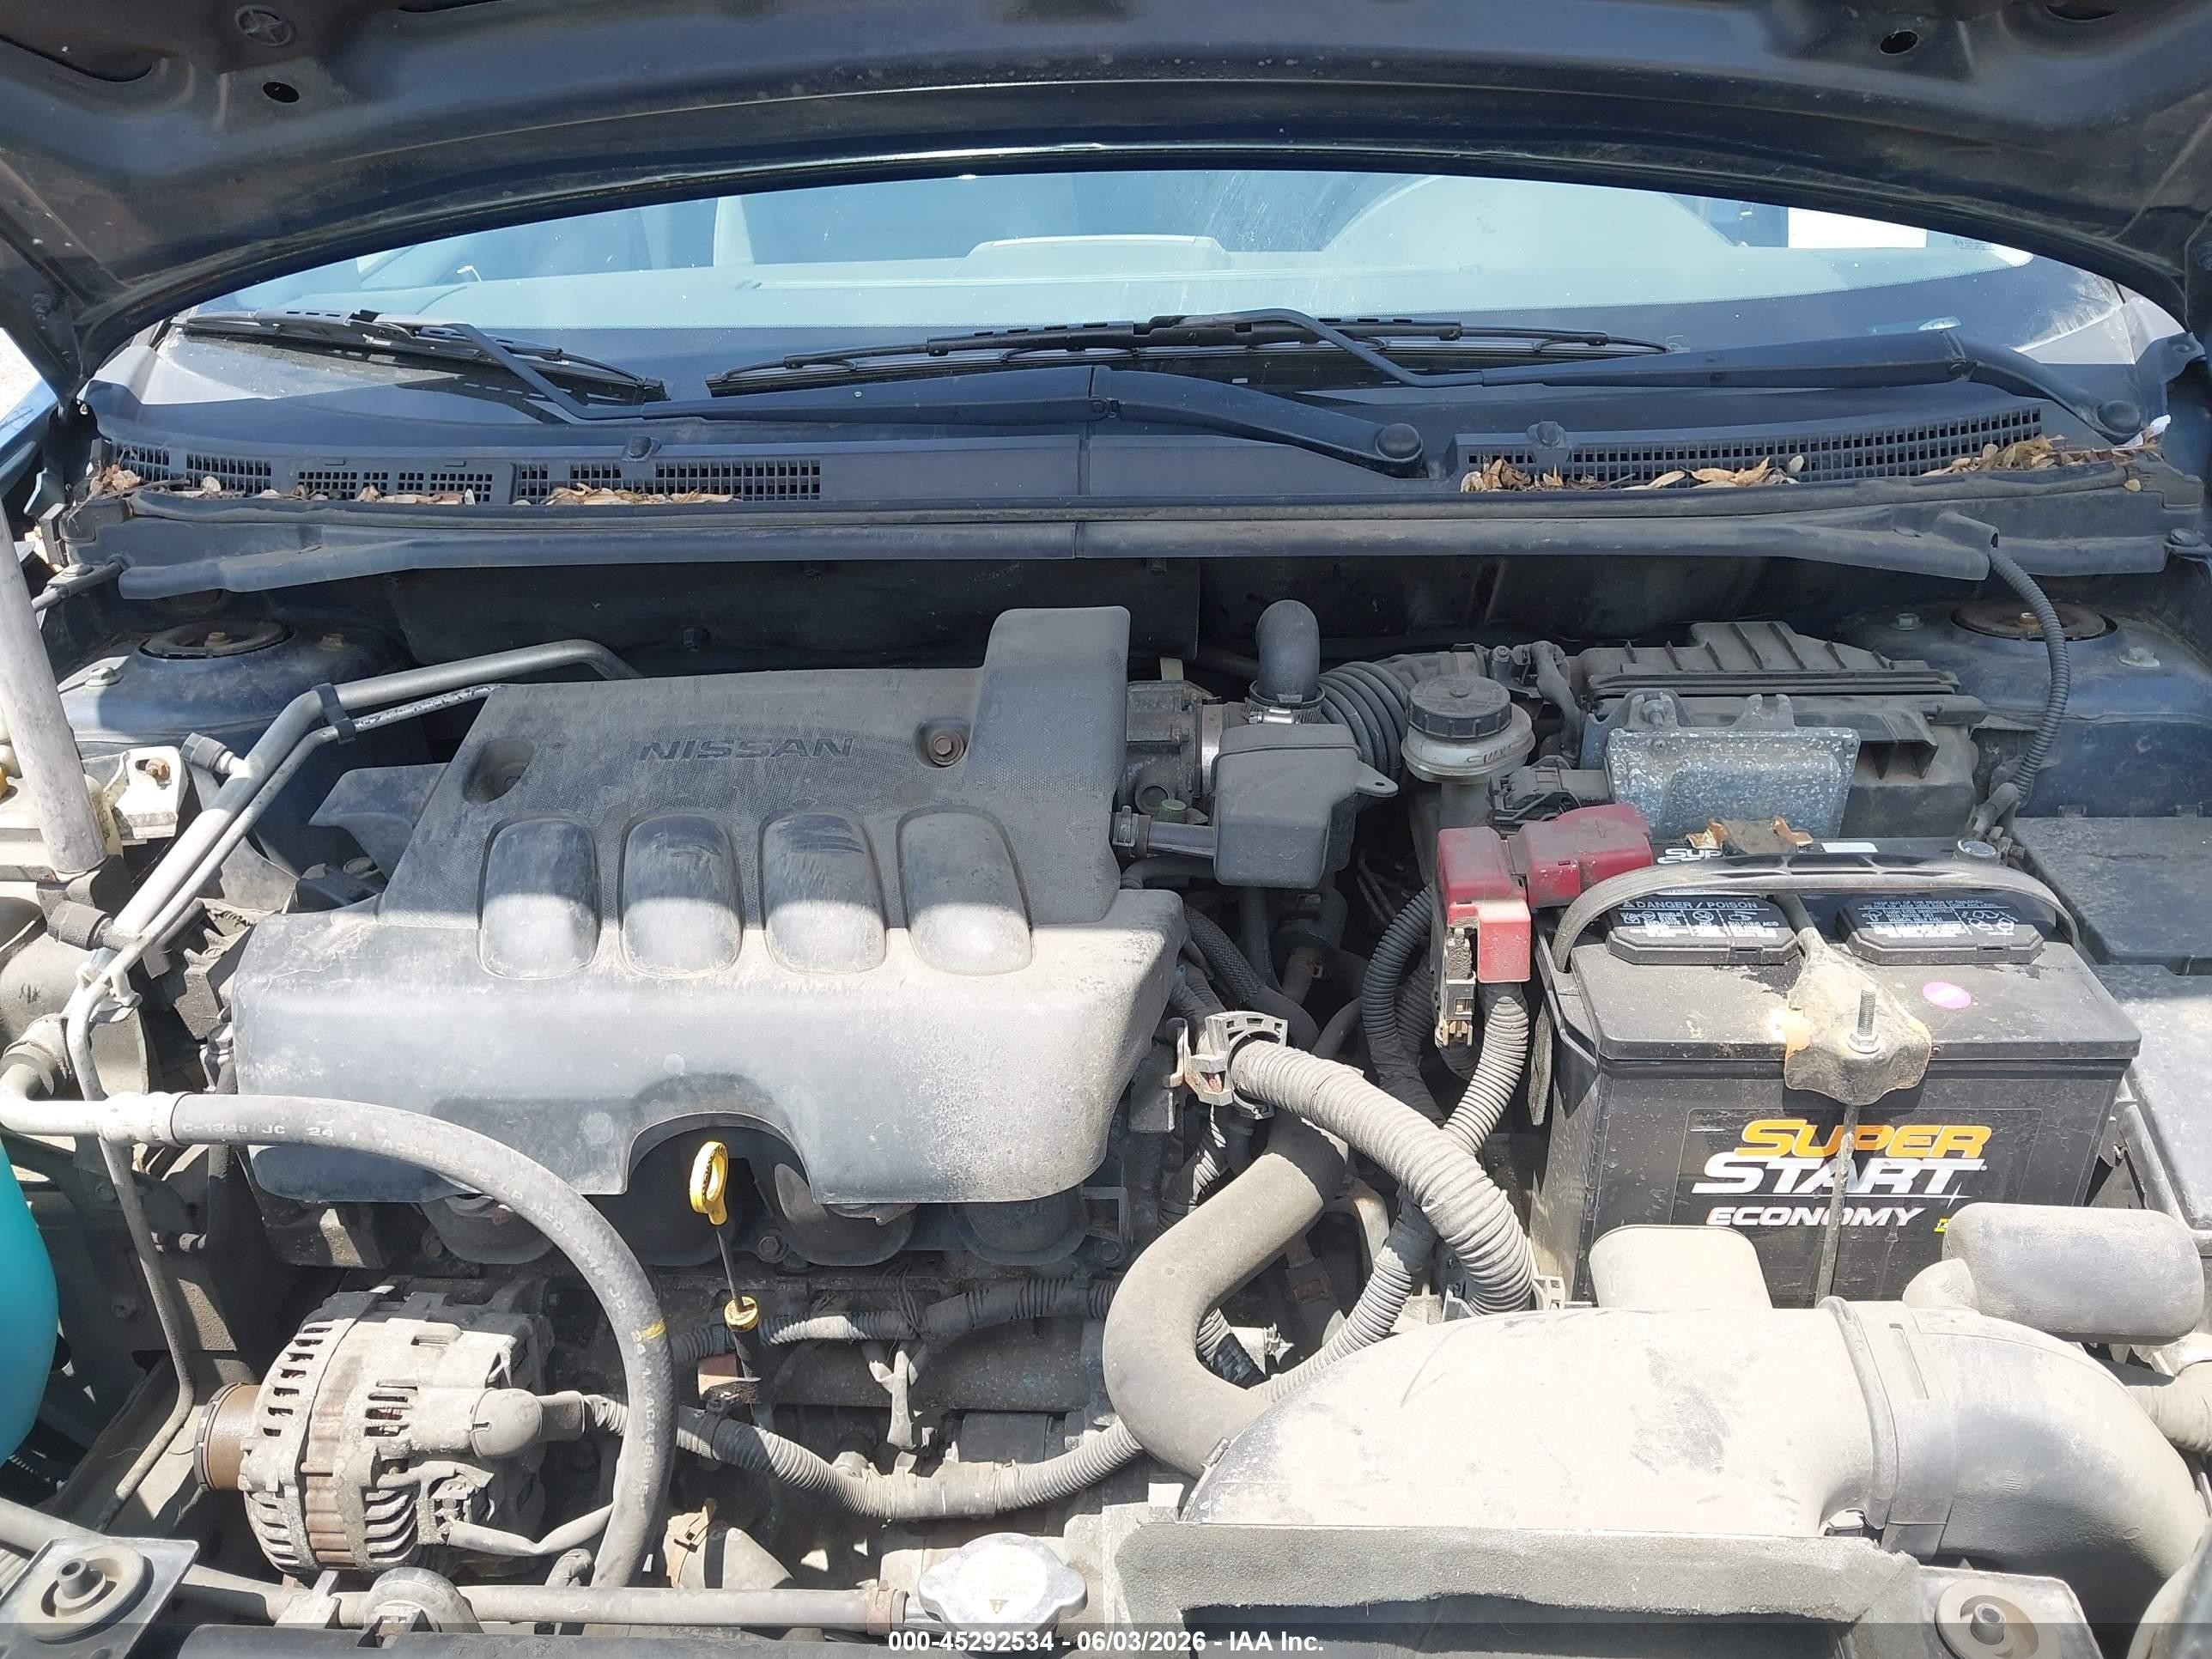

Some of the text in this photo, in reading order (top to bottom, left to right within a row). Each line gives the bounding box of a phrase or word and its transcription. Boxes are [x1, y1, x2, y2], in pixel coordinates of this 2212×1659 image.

[639, 738, 854, 761] NISSAN
[261, 1124, 286, 1135] JC
[307, 1126, 335, 1138] 24
[1734, 1119, 1992, 1158] SUPER
[1690, 1152, 1985, 1194] START
[1705, 1206, 1927, 1226] ECONOMY
